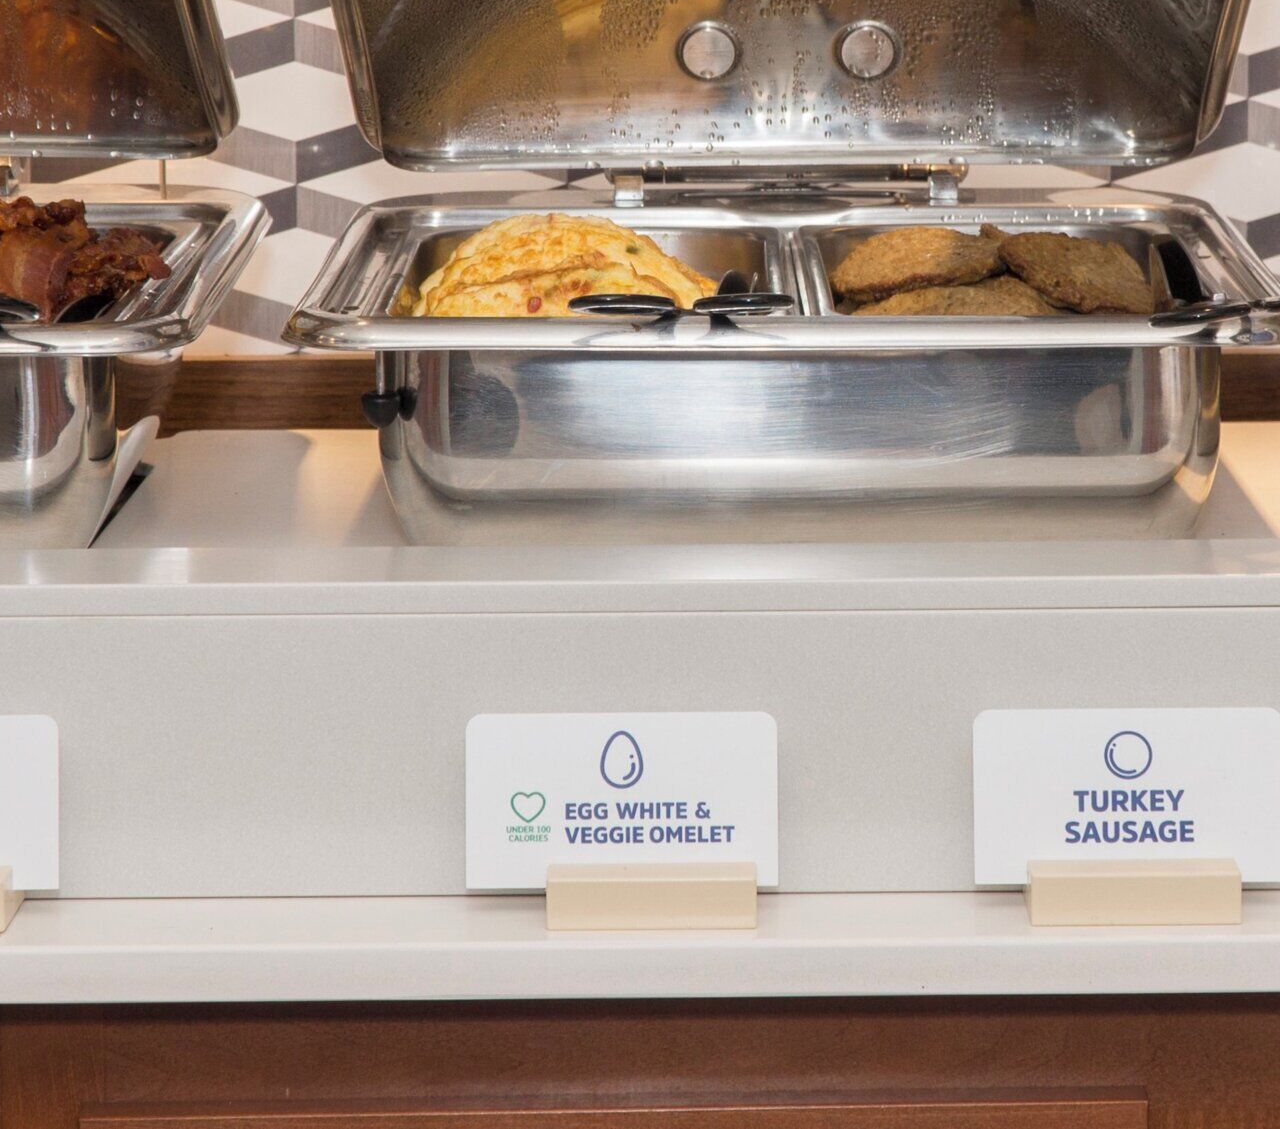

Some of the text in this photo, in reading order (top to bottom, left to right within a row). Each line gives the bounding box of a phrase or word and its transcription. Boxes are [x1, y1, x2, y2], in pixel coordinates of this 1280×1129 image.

[1073, 789, 1185, 812] TURKEY
[564, 801, 711, 821] EGG WHITE &
[506, 825, 551, 834] UNDER 100
[508, 834, 549, 842] CALORIES
[564, 825, 735, 844] VEGGIE OMELET
[1065, 820, 1195, 844] SAUSAGE
